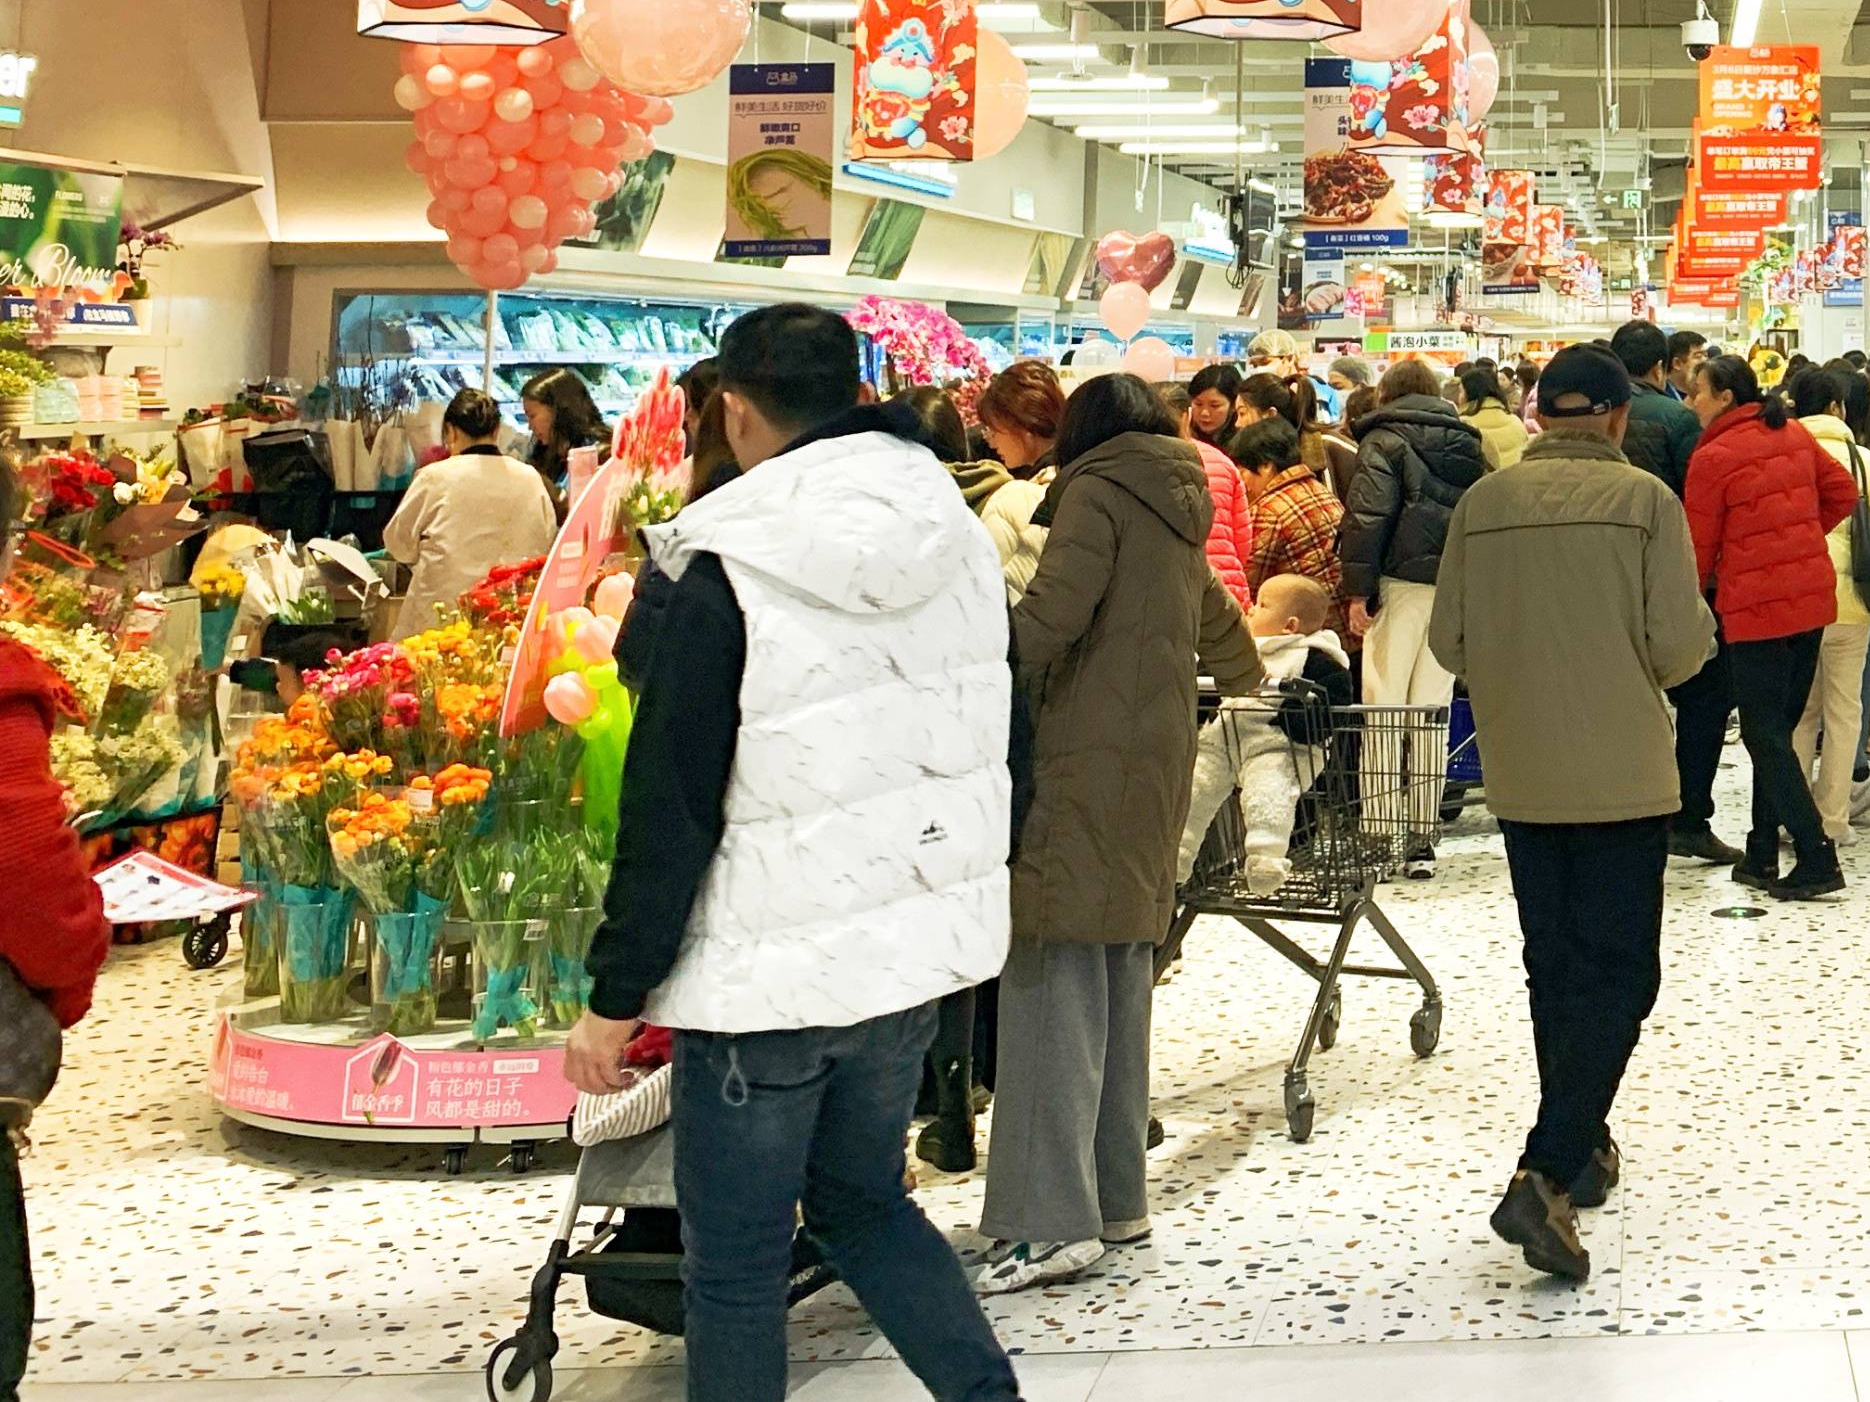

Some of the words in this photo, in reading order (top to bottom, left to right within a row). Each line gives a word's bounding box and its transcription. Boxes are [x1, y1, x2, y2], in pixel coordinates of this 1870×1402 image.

[1712, 78, 1801, 101] 盛大开业
[426, 1076, 523, 1098] 有花的日子
[424, 1098, 530, 1119] 风都是甜的。
